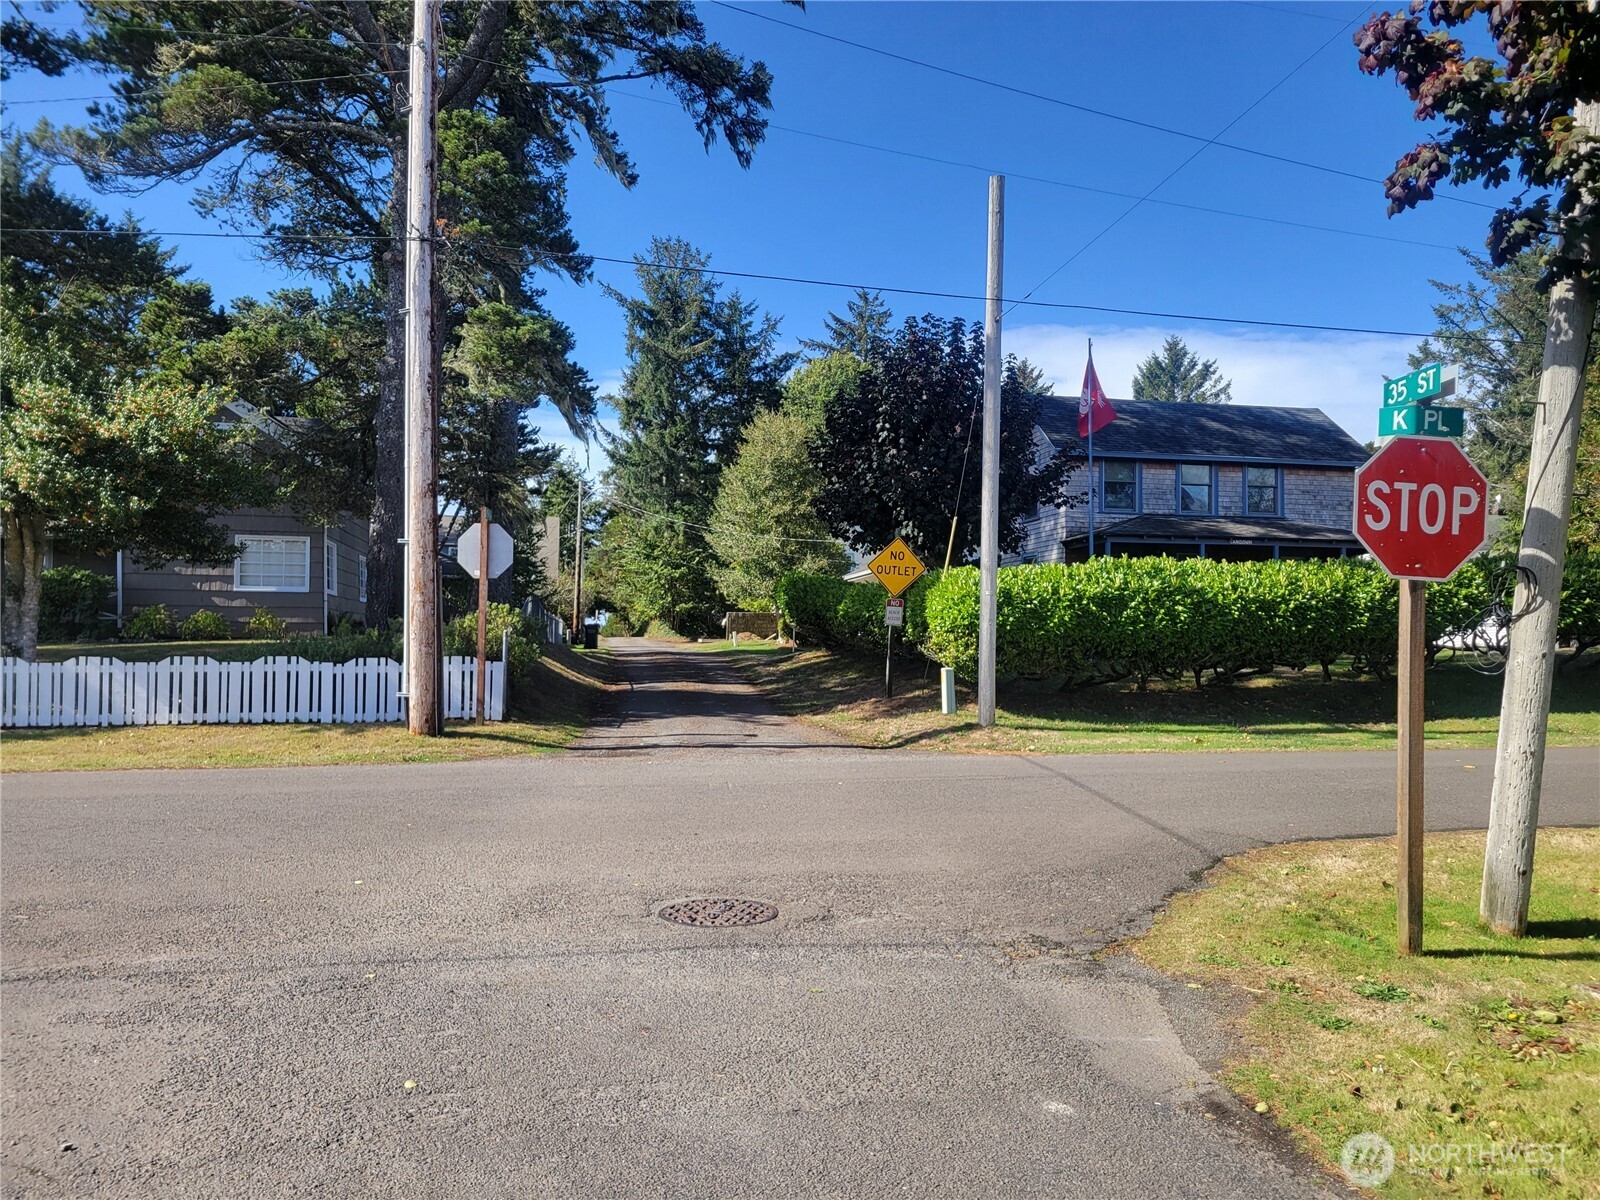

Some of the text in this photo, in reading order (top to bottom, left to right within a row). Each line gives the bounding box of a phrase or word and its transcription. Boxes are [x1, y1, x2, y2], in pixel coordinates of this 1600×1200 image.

[1387, 367, 1437, 405] 35 ST
[1392, 409, 1449, 432] K PL
[1364, 480, 1479, 535] STOP
[890, 550, 905, 561] NO
[876, 564, 917, 577] OUTLET
